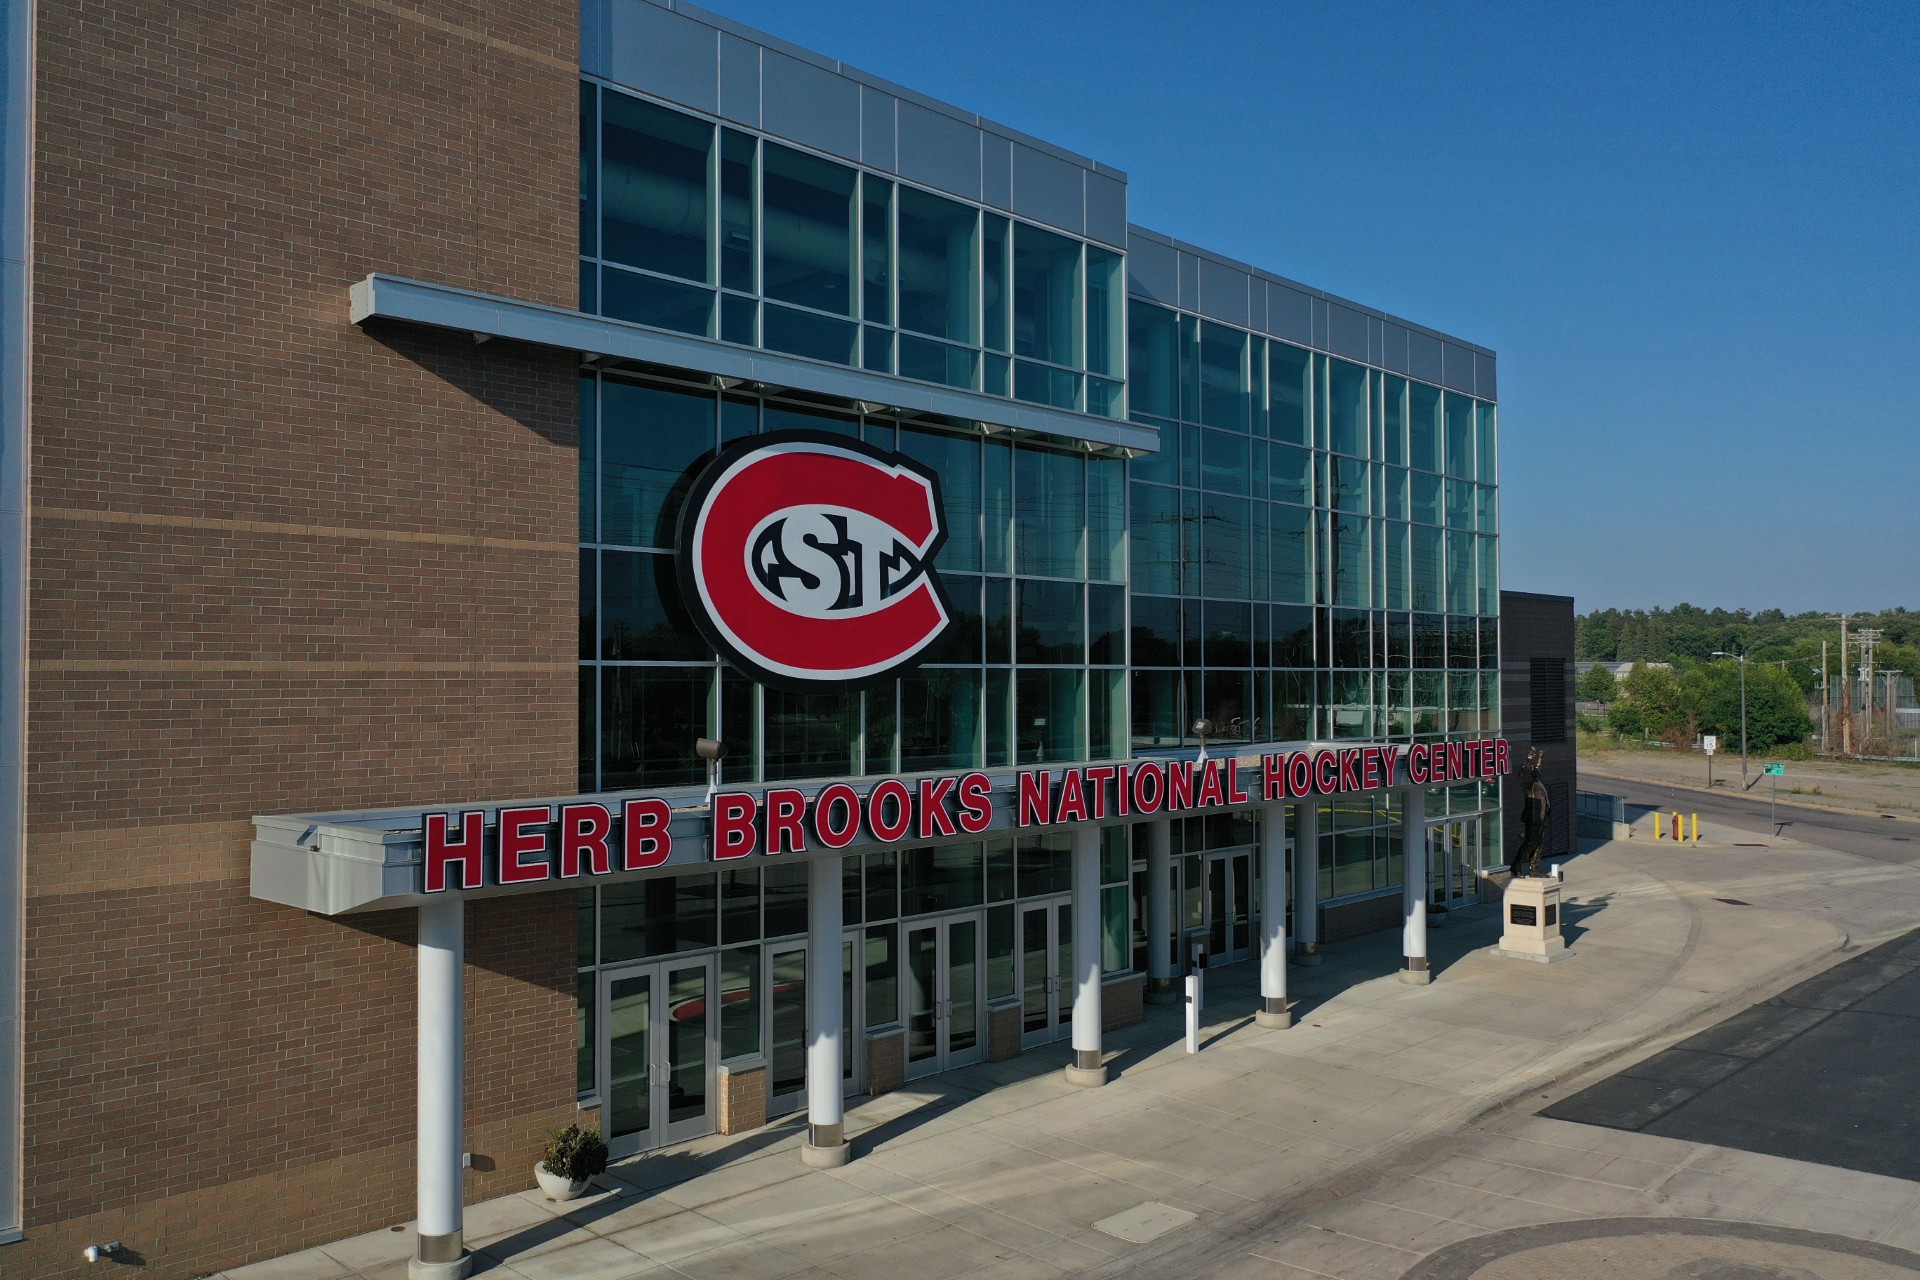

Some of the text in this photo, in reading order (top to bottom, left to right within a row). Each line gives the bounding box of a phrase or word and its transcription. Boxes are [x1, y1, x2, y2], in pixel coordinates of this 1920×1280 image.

[421, 738, 1511, 894] HERB BROOKS NATIONAL HOCKEY CENTER
